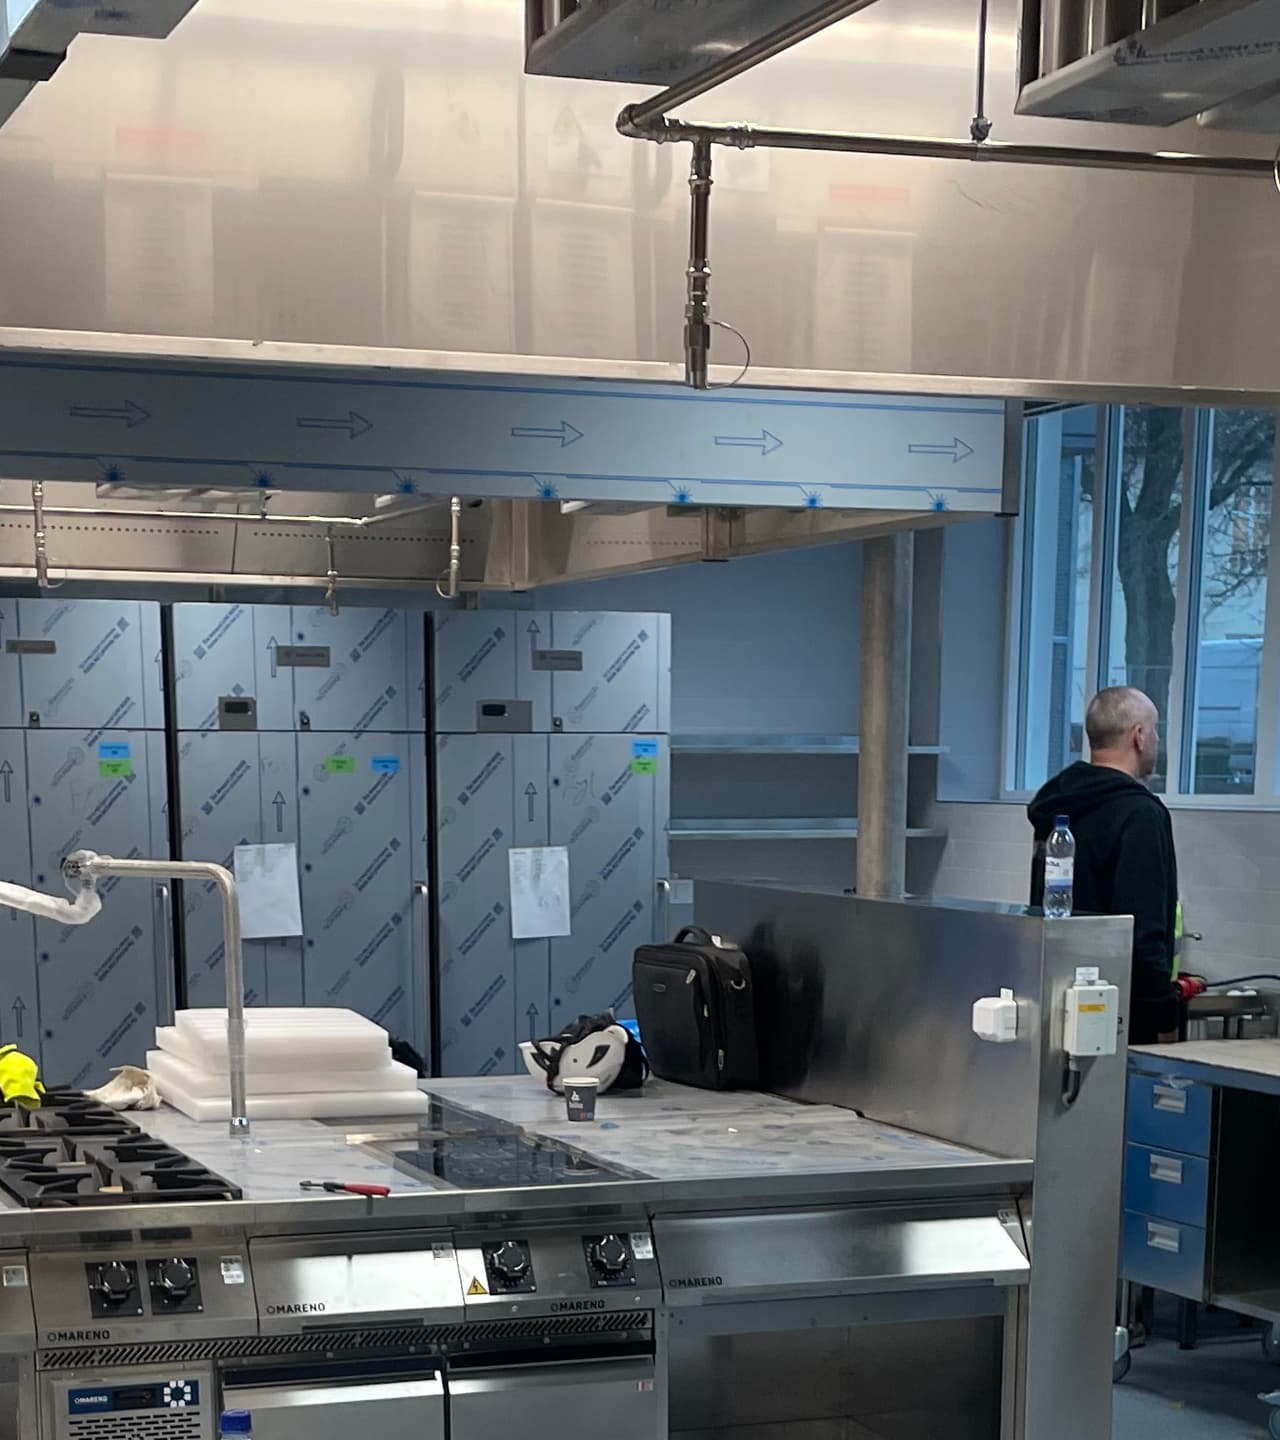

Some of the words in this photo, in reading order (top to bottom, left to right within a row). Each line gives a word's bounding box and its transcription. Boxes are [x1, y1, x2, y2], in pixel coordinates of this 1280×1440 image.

[679, 1276, 723, 1288] MARENO
[276, 1303, 326, 1314] MARENO
[560, 1300, 606, 1311] MARENO
[61, 1329, 111, 1341] MARENO
